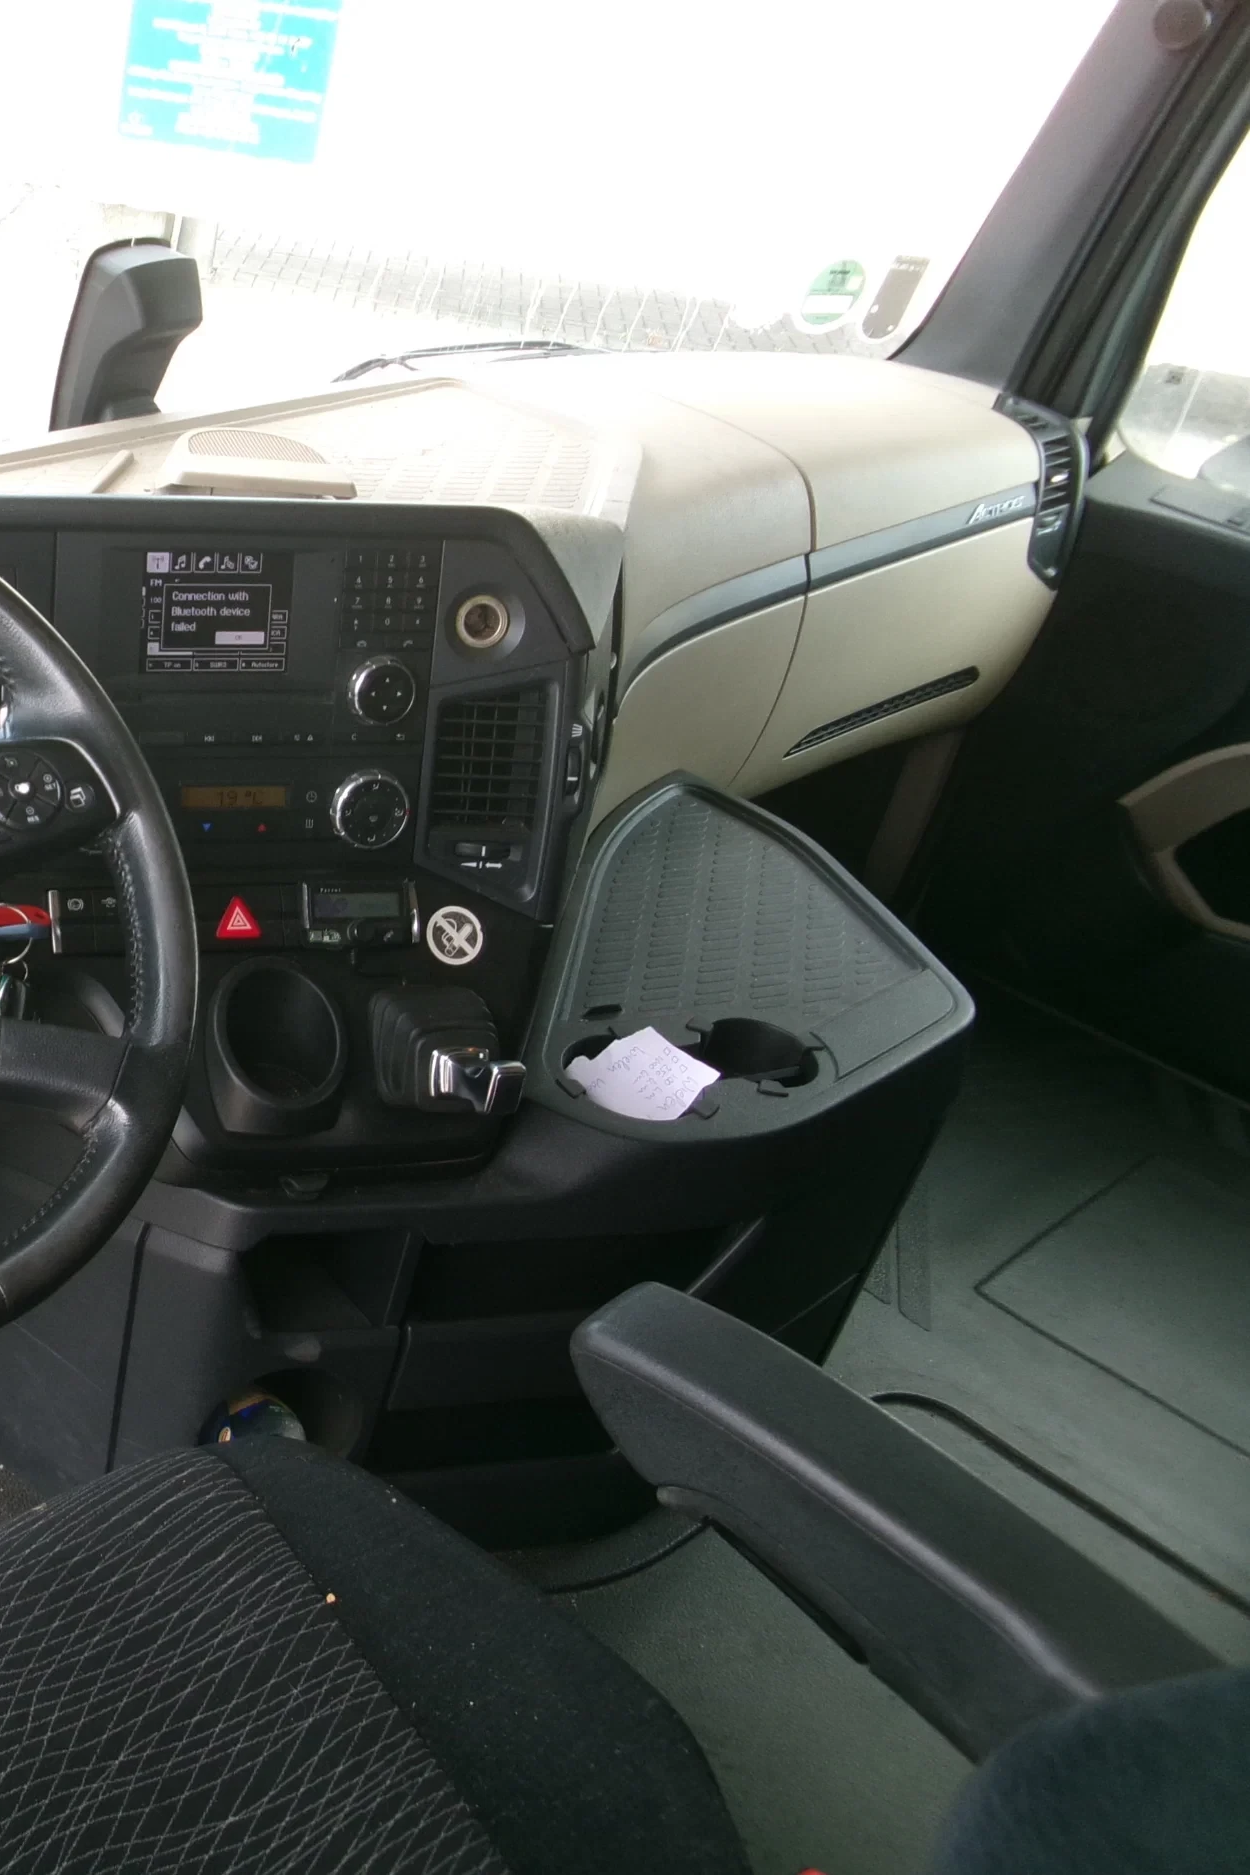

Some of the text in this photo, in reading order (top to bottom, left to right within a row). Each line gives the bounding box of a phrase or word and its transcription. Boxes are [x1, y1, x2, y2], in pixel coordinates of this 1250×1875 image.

[149, 578, 163, 587] FM
[171, 590, 249, 602] Connection with
[170, 606, 251, 617] Bluetooth device
[170, 621, 197, 632] failed
[251, 661, 279, 669] Autostore
[44, 783, 56, 792] SET
[216, 790, 238, 806] 19
[26, 815, 40, 824] RES
[319, 886, 342, 894] Parrot
